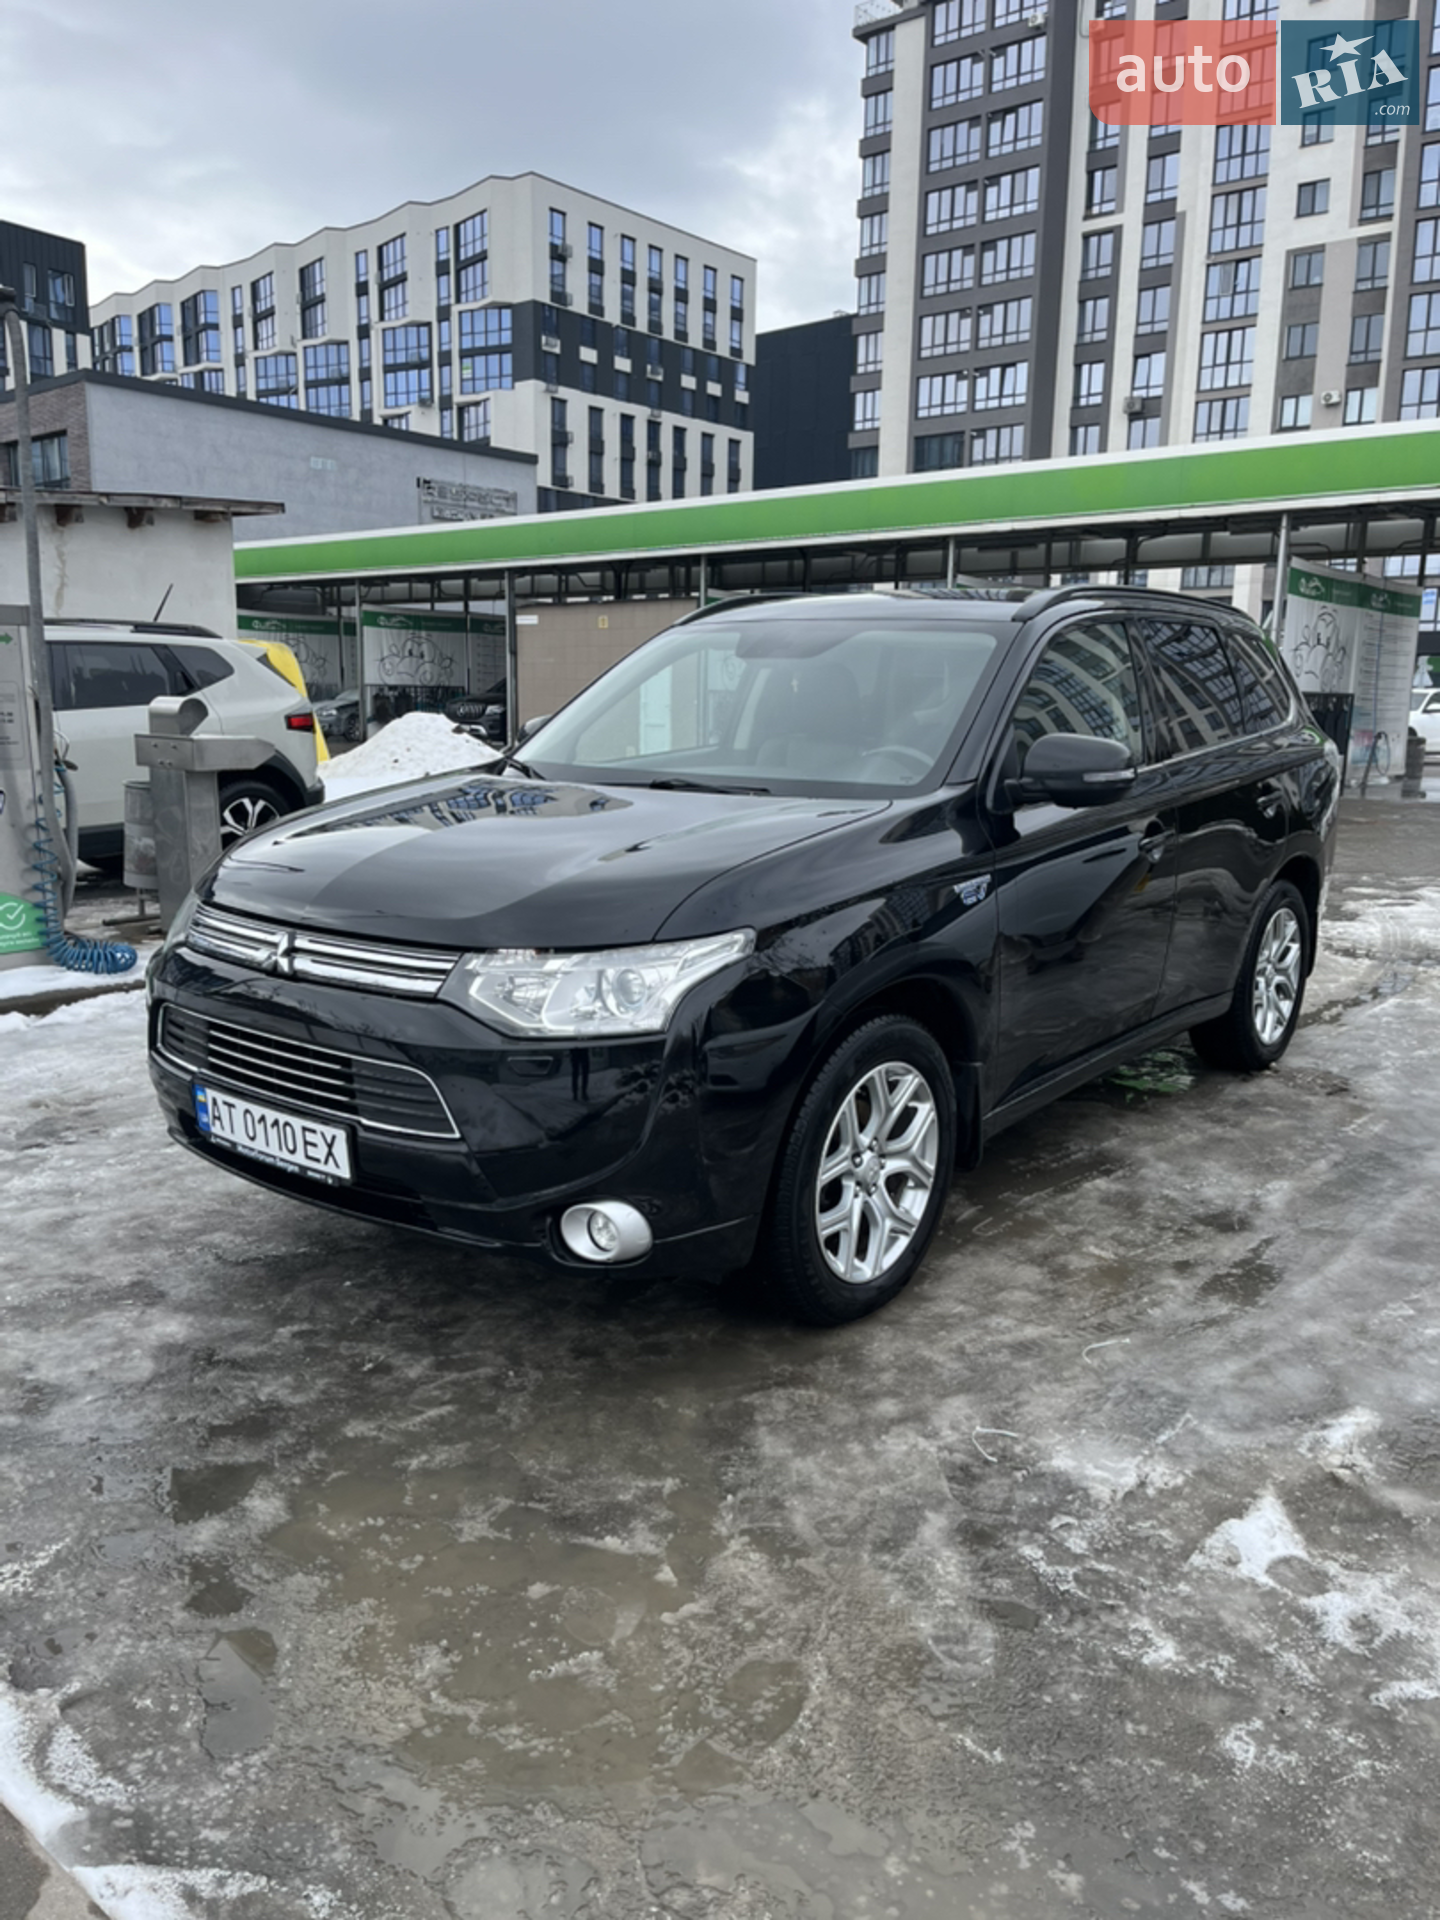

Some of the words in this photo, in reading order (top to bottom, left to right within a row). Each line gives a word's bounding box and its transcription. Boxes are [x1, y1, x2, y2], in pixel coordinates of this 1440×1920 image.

[211, 1096, 236, 1134] AT
[243, 1109, 297, 1154] 0110
[301, 1126, 340, 1169] EX
